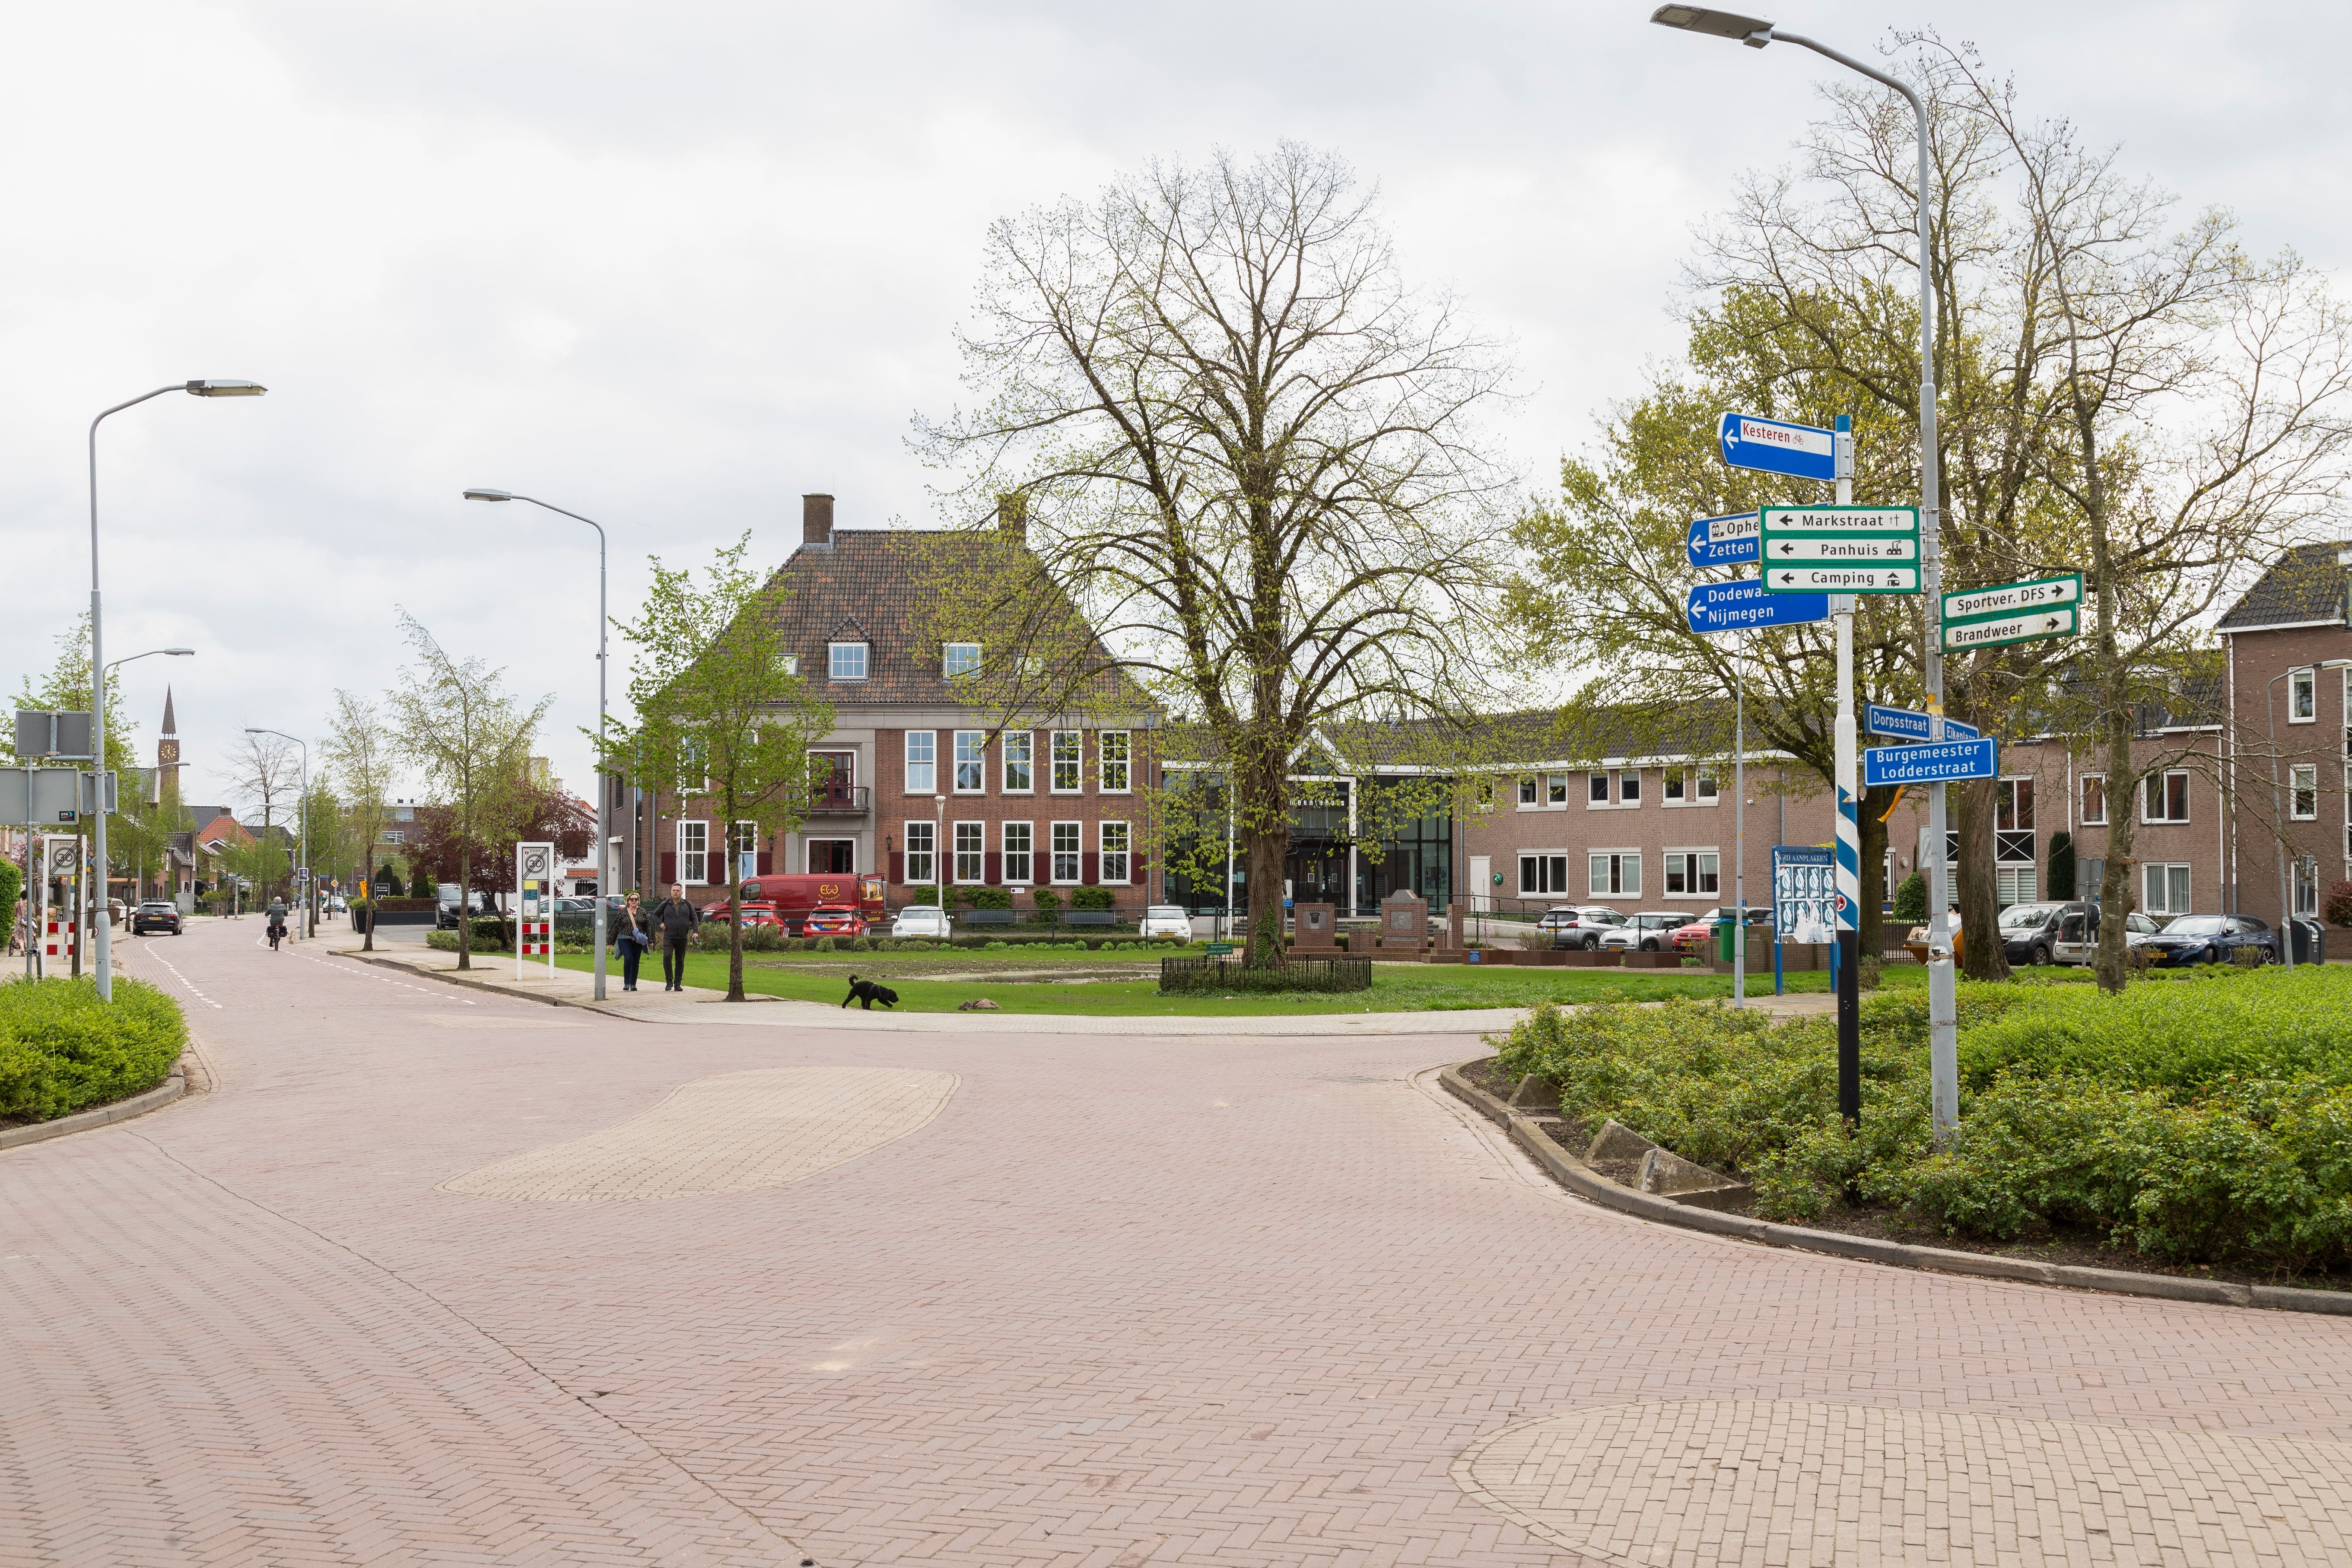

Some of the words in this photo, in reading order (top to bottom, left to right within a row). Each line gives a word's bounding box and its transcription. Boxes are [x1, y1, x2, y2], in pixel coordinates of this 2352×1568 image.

[1743, 422, 1790, 443] Kesteren
[1802, 515, 1883, 526] Markstraat
[1709, 542, 1753, 557] Zetten
[1821, 544, 1878, 555] Panhuis
[1811, 572, 1874, 586] Camping
[1708, 588, 1775, 602] Dodewa
[1957, 594, 2016, 613] Sportver.
[2021, 587, 2045, 601] DFS
[1709, 607, 1774, 626] Nijmegen
[1956, 624, 2022, 642] Brandweer
[1873, 711, 1927, 732] Dorpsstraat
[1877, 745, 1980, 764] Burgemeester
[1882, 761, 1975, 779] Lodderstraat
